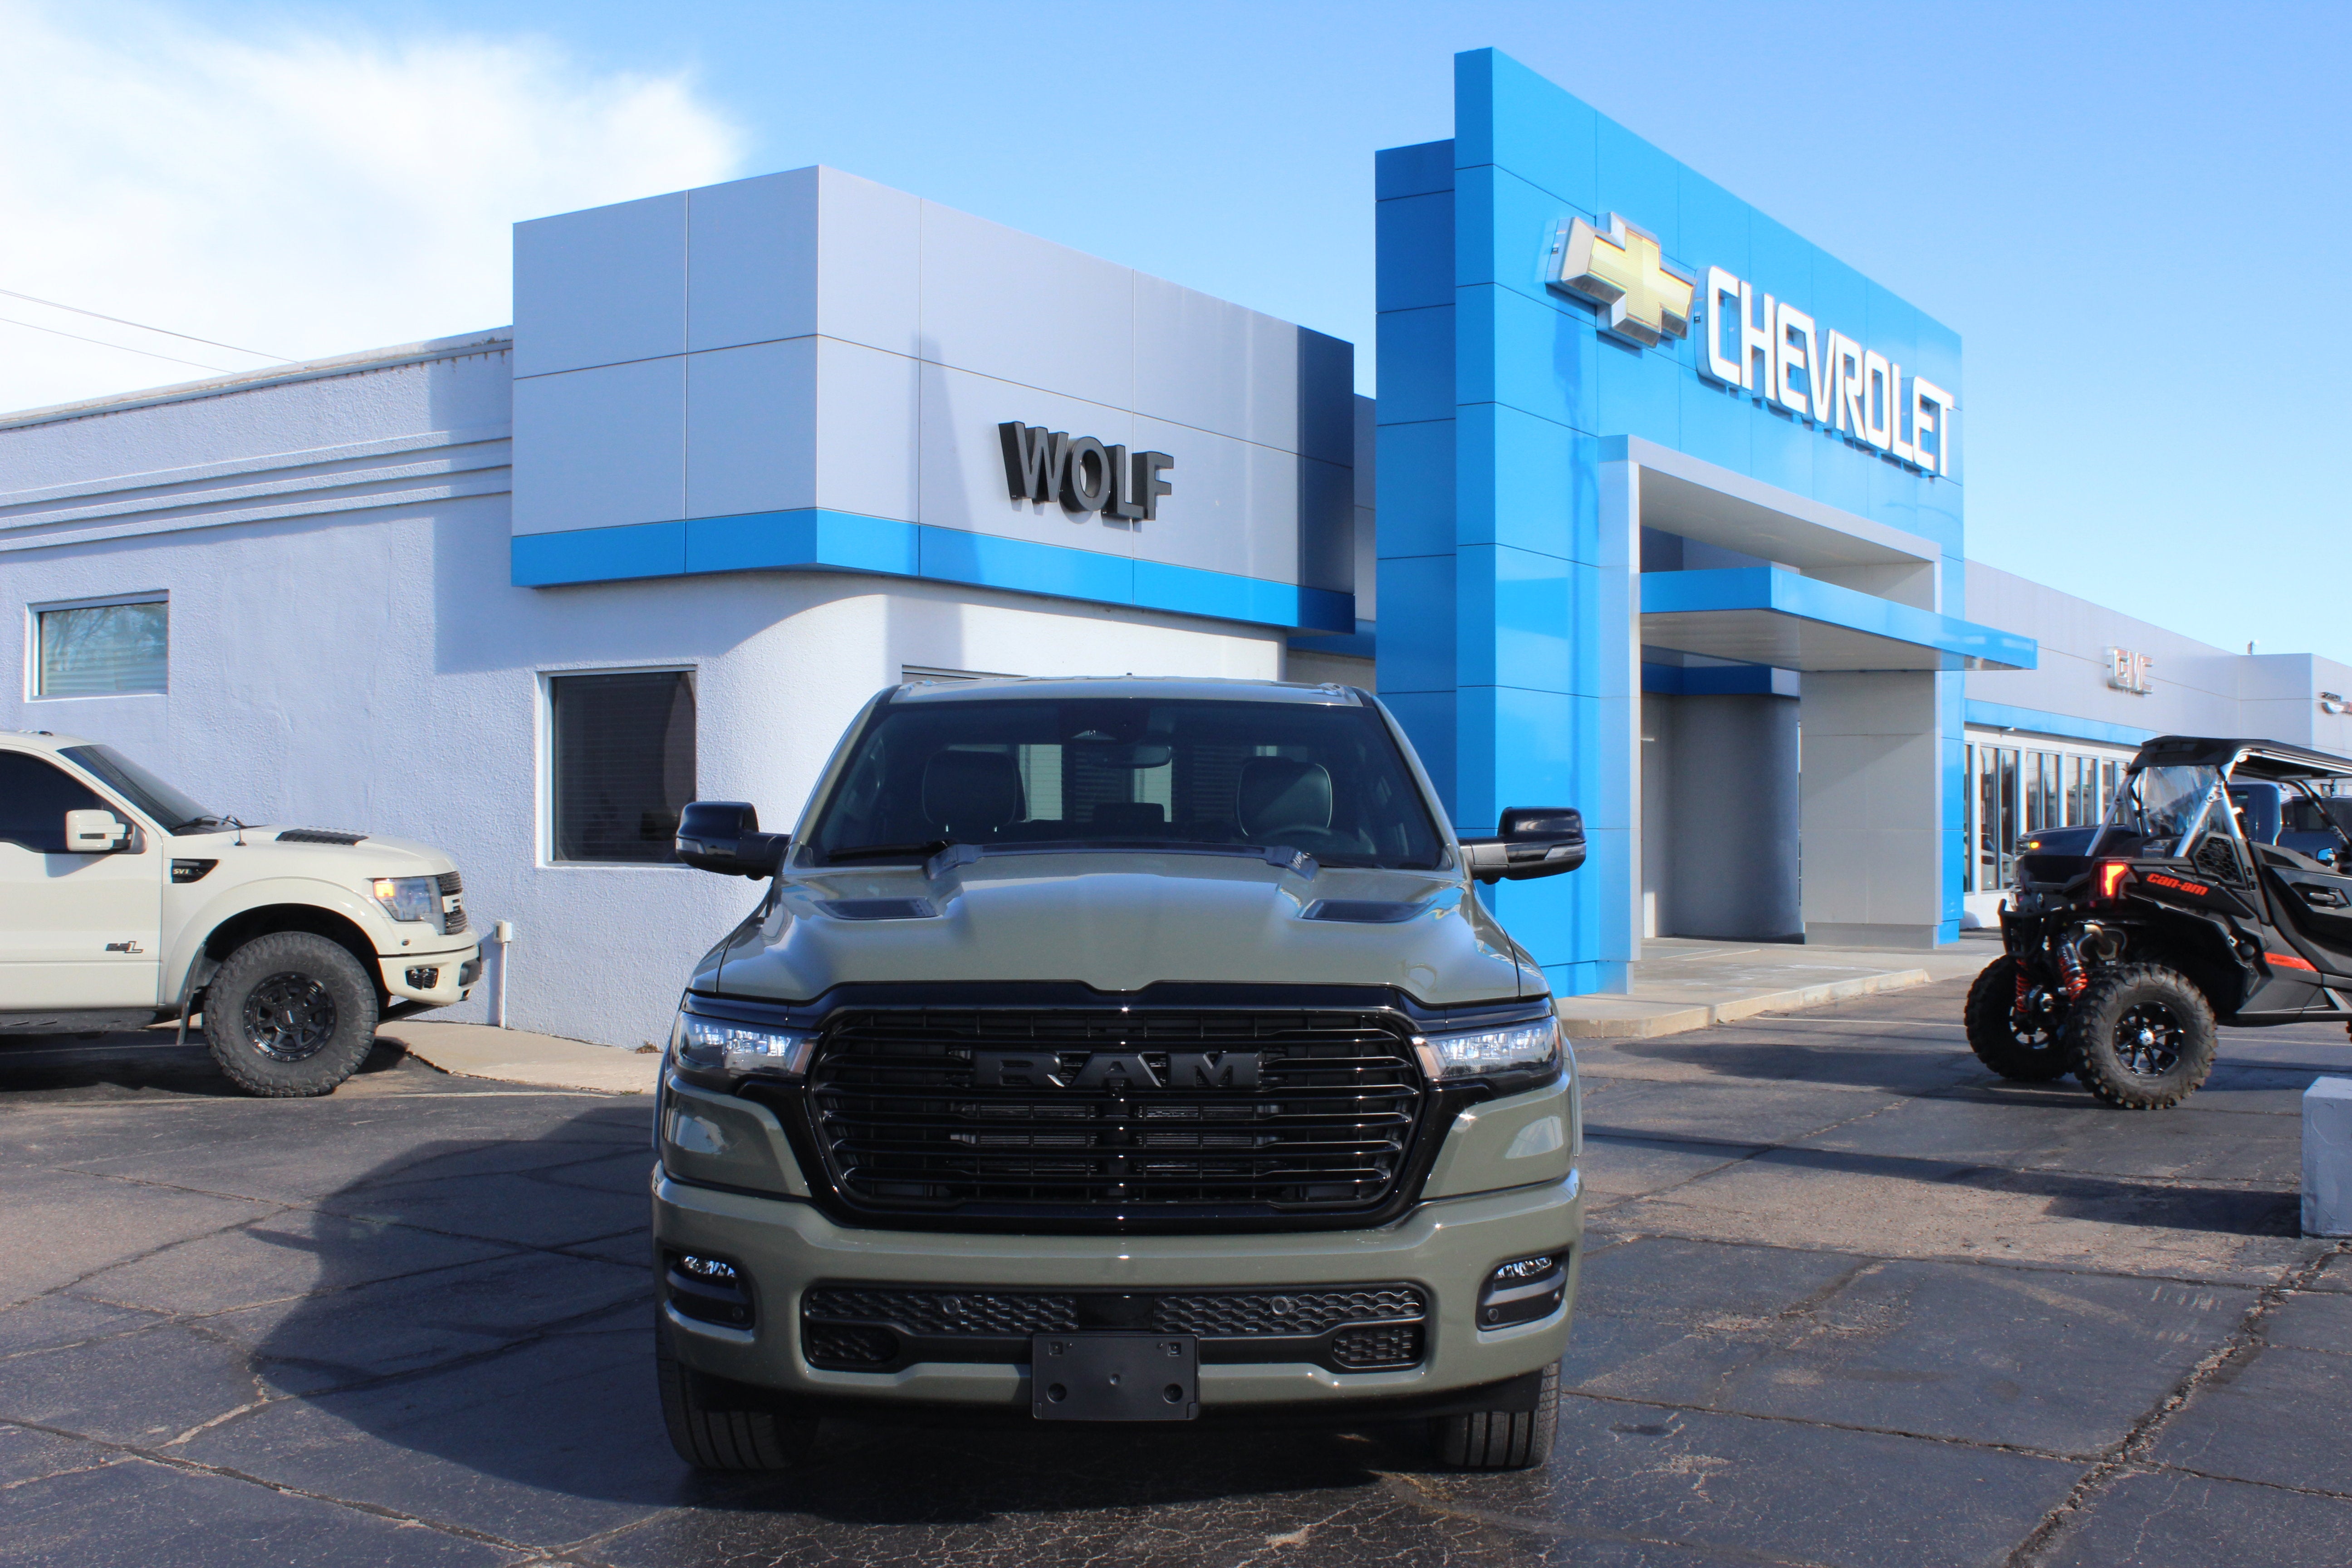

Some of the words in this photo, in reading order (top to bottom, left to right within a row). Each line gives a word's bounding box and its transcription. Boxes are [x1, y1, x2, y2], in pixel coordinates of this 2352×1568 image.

[1698, 265, 1954, 477] CHEVROLET
[998, 421, 1174, 521] WOLF
[2146, 872, 2209, 896] can-am
[974, 1051, 1260, 1088] RAM
